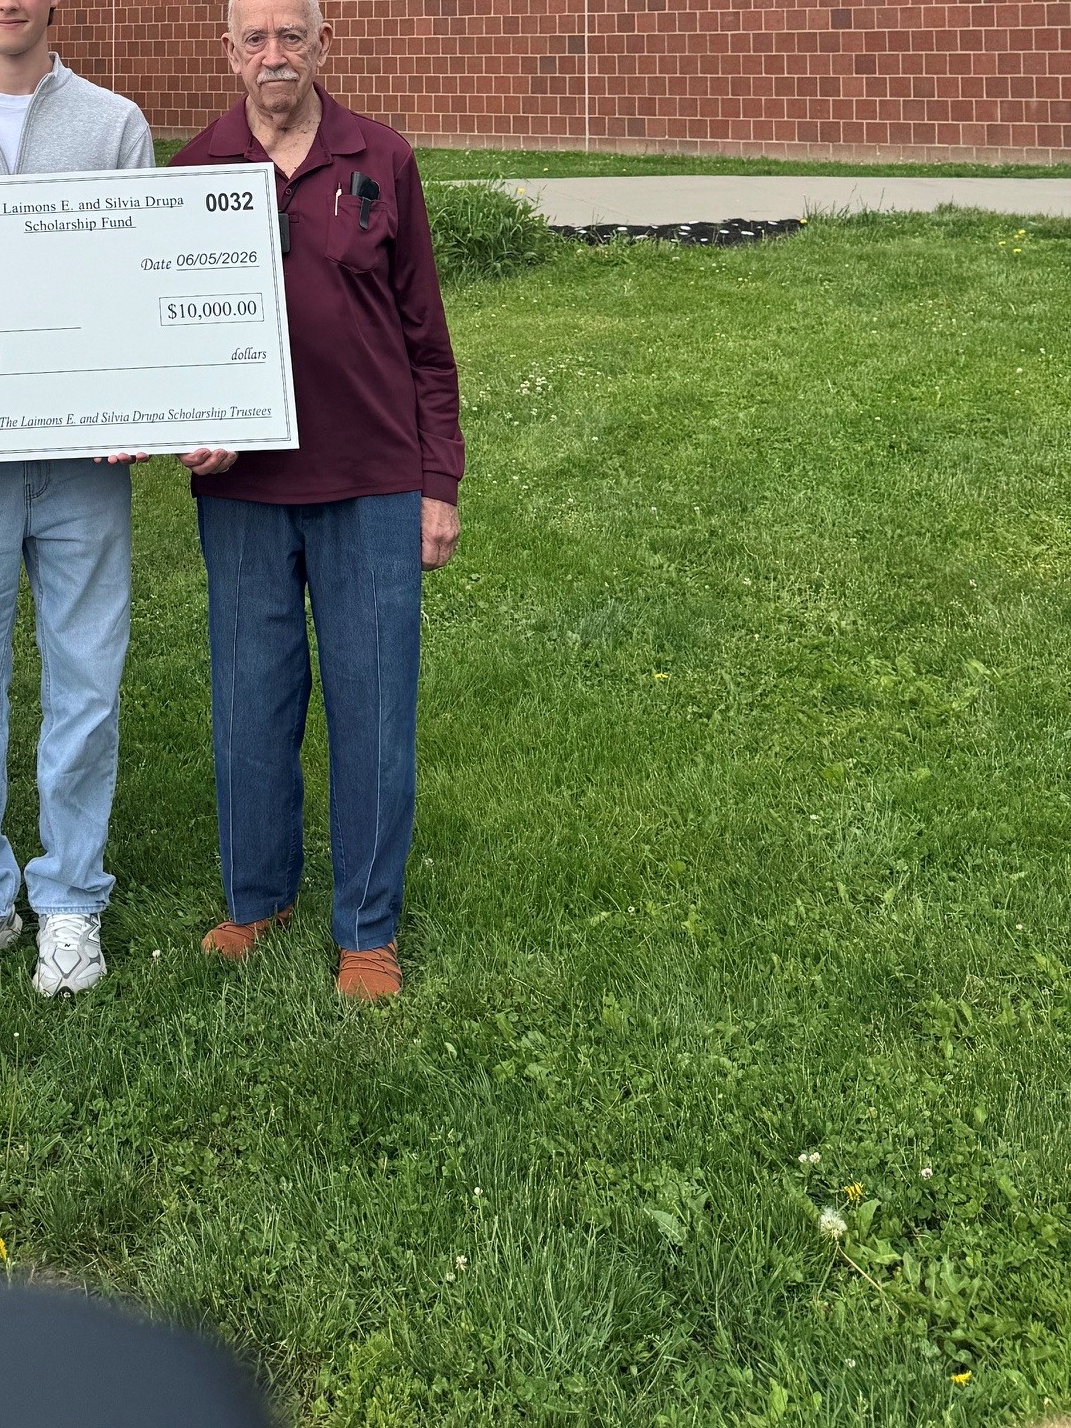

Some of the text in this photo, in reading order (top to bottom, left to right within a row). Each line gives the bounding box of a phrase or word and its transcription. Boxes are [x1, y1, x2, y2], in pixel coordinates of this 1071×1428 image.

[3, 201, 56, 213] Laimons
[61, 200, 74, 211] E.
[79, 198, 101, 209] and
[105, 197, 140, 208] Silvia
[145, 195, 184, 208] Drupa
[205, 191, 254, 212] 0032
[24, 216, 133, 232] Scholarship Fund
[140, 251, 257, 271] Date 06/05/2026
[167, 300, 257, 320] $10,000.00
[231, 347, 267, 360] dollars
[0, 416, 18, 428] The
[20, 416, 63, 427] Laimons
[66, 413, 76, 425] E.
[79, 412, 99, 424] and
[101, 411, 130, 423] Silvia
[132, 410, 165, 422] Drupa
[167, 407, 227, 420] Scholarship
[230, 406, 272, 417] Trustees
